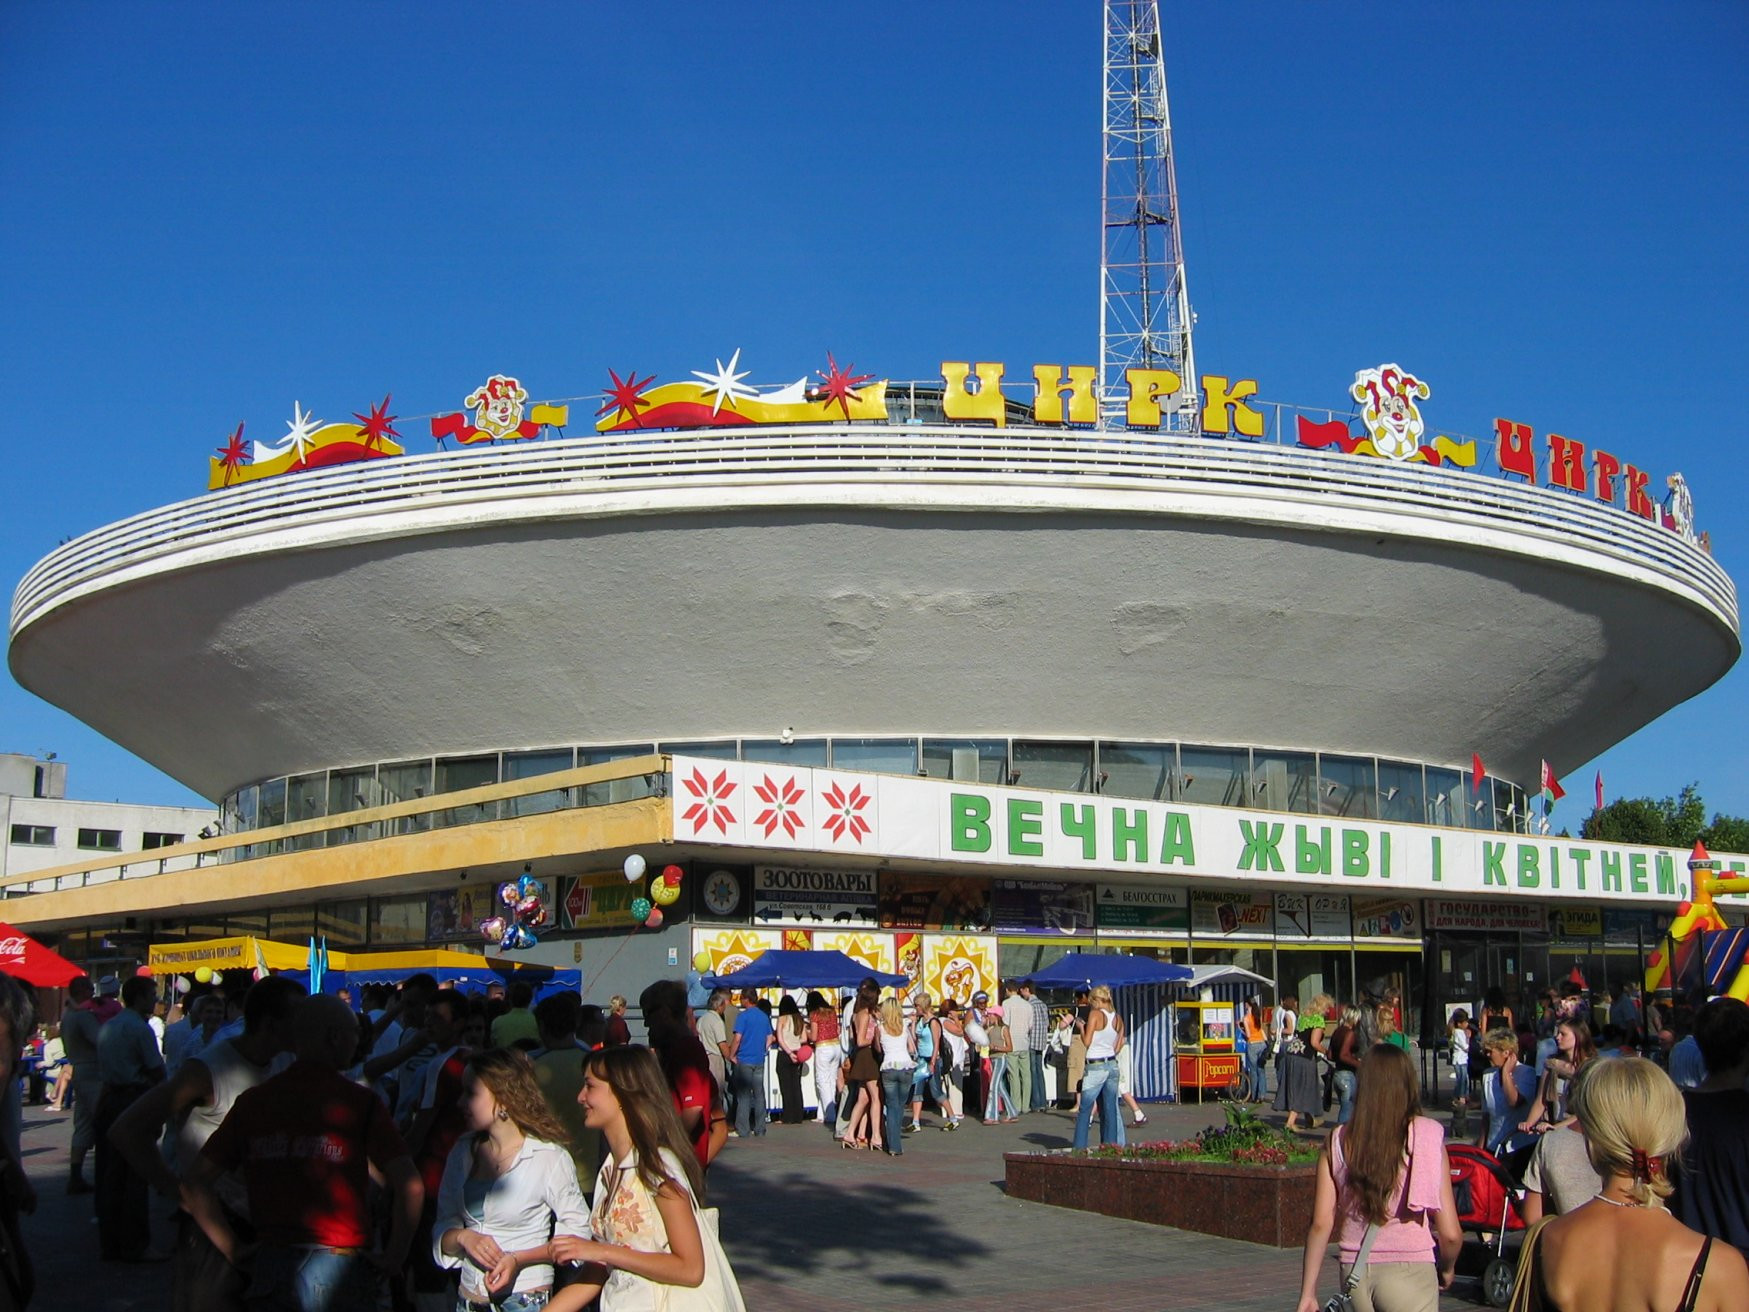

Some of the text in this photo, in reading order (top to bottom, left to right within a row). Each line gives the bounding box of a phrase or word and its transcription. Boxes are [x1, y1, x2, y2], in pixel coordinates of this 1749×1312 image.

[941, 361, 1264, 438] ЦИРК
[1493, 417, 1653, 521] ЦИРК
[950, 793, 1195, 866] ВЕЧНА
[1237, 819, 1391, 878] ЖЫВІ
[763, 869, 873, 892] ЗООТОВАРЫ
[1123, 891, 1177, 904] БЕЛГОССТРАХ
[1566, 911, 1598, 923] ЭГИДА
[1205, 1060, 1235, 1078] Popcorn
